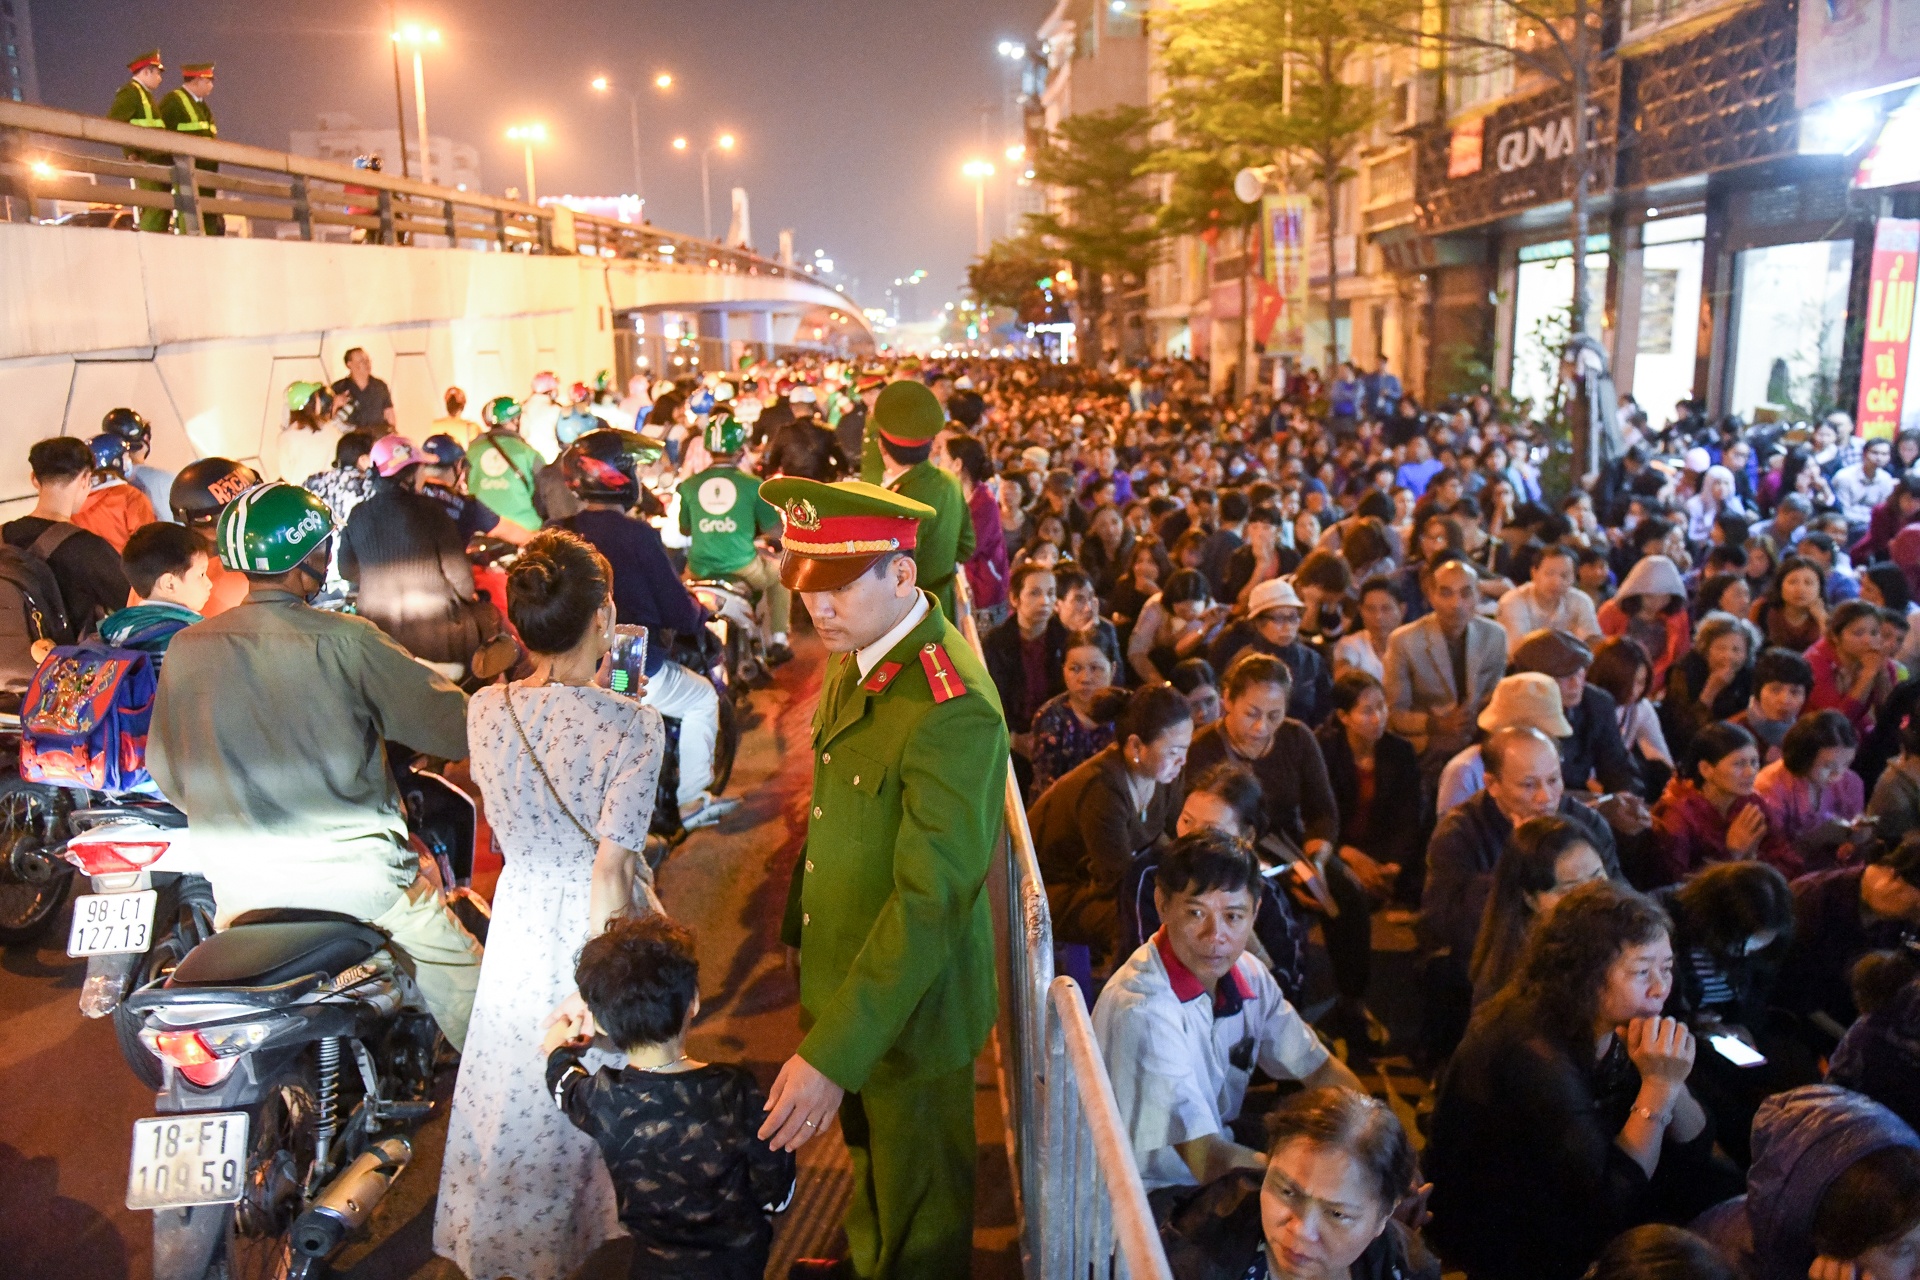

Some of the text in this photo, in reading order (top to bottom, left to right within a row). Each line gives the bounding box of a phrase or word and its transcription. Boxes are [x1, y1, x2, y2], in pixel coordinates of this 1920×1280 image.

[285, 508, 321, 545] Grab
[699, 516, 737, 533] Grab
[78, 923, 146, 951] 127.13
[153, 1120, 228, 1159] 18-F1
